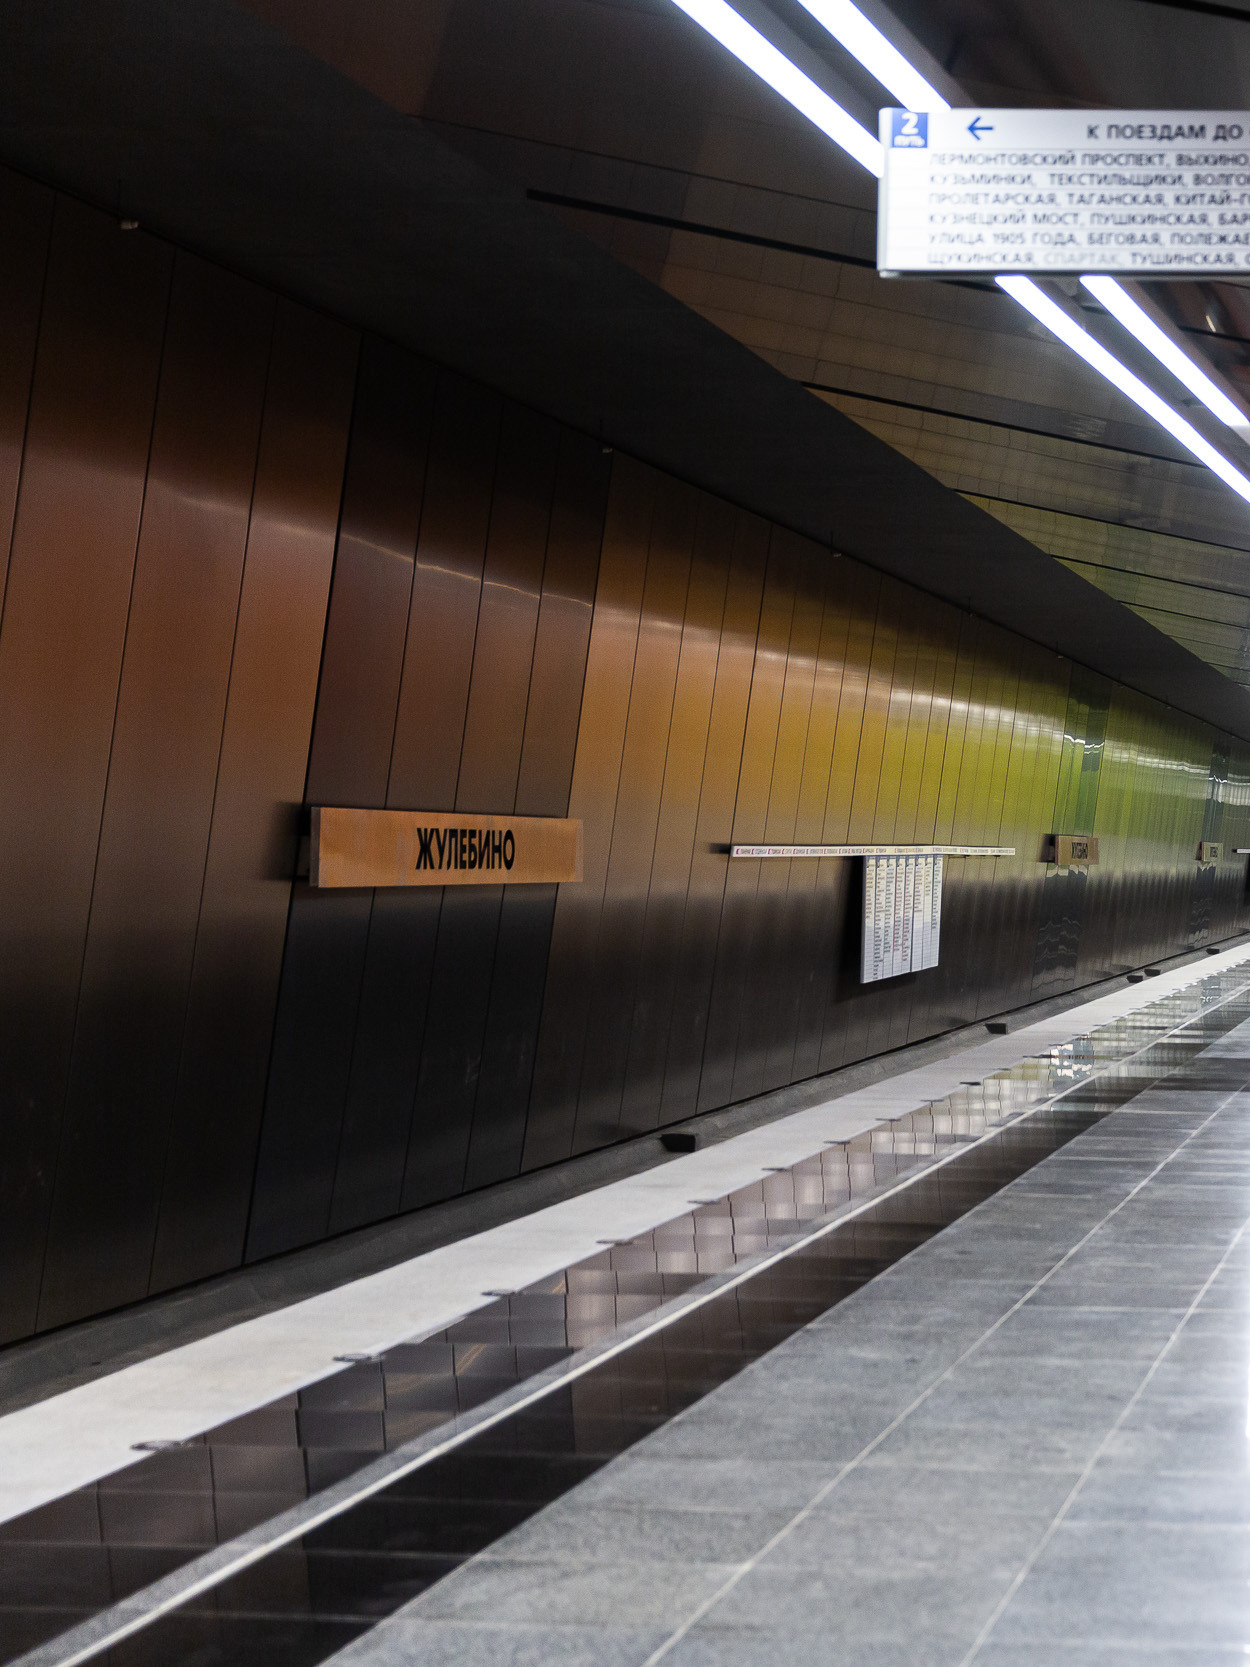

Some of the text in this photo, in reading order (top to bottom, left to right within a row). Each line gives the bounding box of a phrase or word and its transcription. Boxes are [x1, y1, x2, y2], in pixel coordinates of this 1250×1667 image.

[901, 112, 918, 134] 2
[1087, 125, 1099, 139] К
[1107, 124, 1206, 141] ПОЕЗДАМ
[1213, 124, 1243, 141] ДО
[929, 150, 1077, 166] ЛЕРМОНТОВСКИЙ
[1081, 153, 1171, 168] ПРОСПЕКТ,
[929, 173, 1036, 187] КУЗЬМИНКИ,
[1048, 173, 1187, 188] ТЕКСТИЛЬЩИКИ,
[929, 193, 1061, 208] ПРОЛЕТАРСКАЯ,
[1068, 193, 1168, 208] ТАГАНСКАЯ,
[929, 210, 1026, 226] КУЗНЕЦКИЙ
[1032, 213, 1085, 226] МОСТ,
[1090, 213, 1213, 227] ПУШКИНСКАЯ,
[929, 233, 984, 246] УЛИЦА
[994, 233, 1025, 245] 1905
[1032, 233, 1082, 247] ГОДА,
[1087, 233, 1163, 247] БЕГОВАЯ,
[1131, 252, 1237, 267] ТУШИНСКАЯ,
[416, 828, 515, 870] ЖУЛЕБИНО
